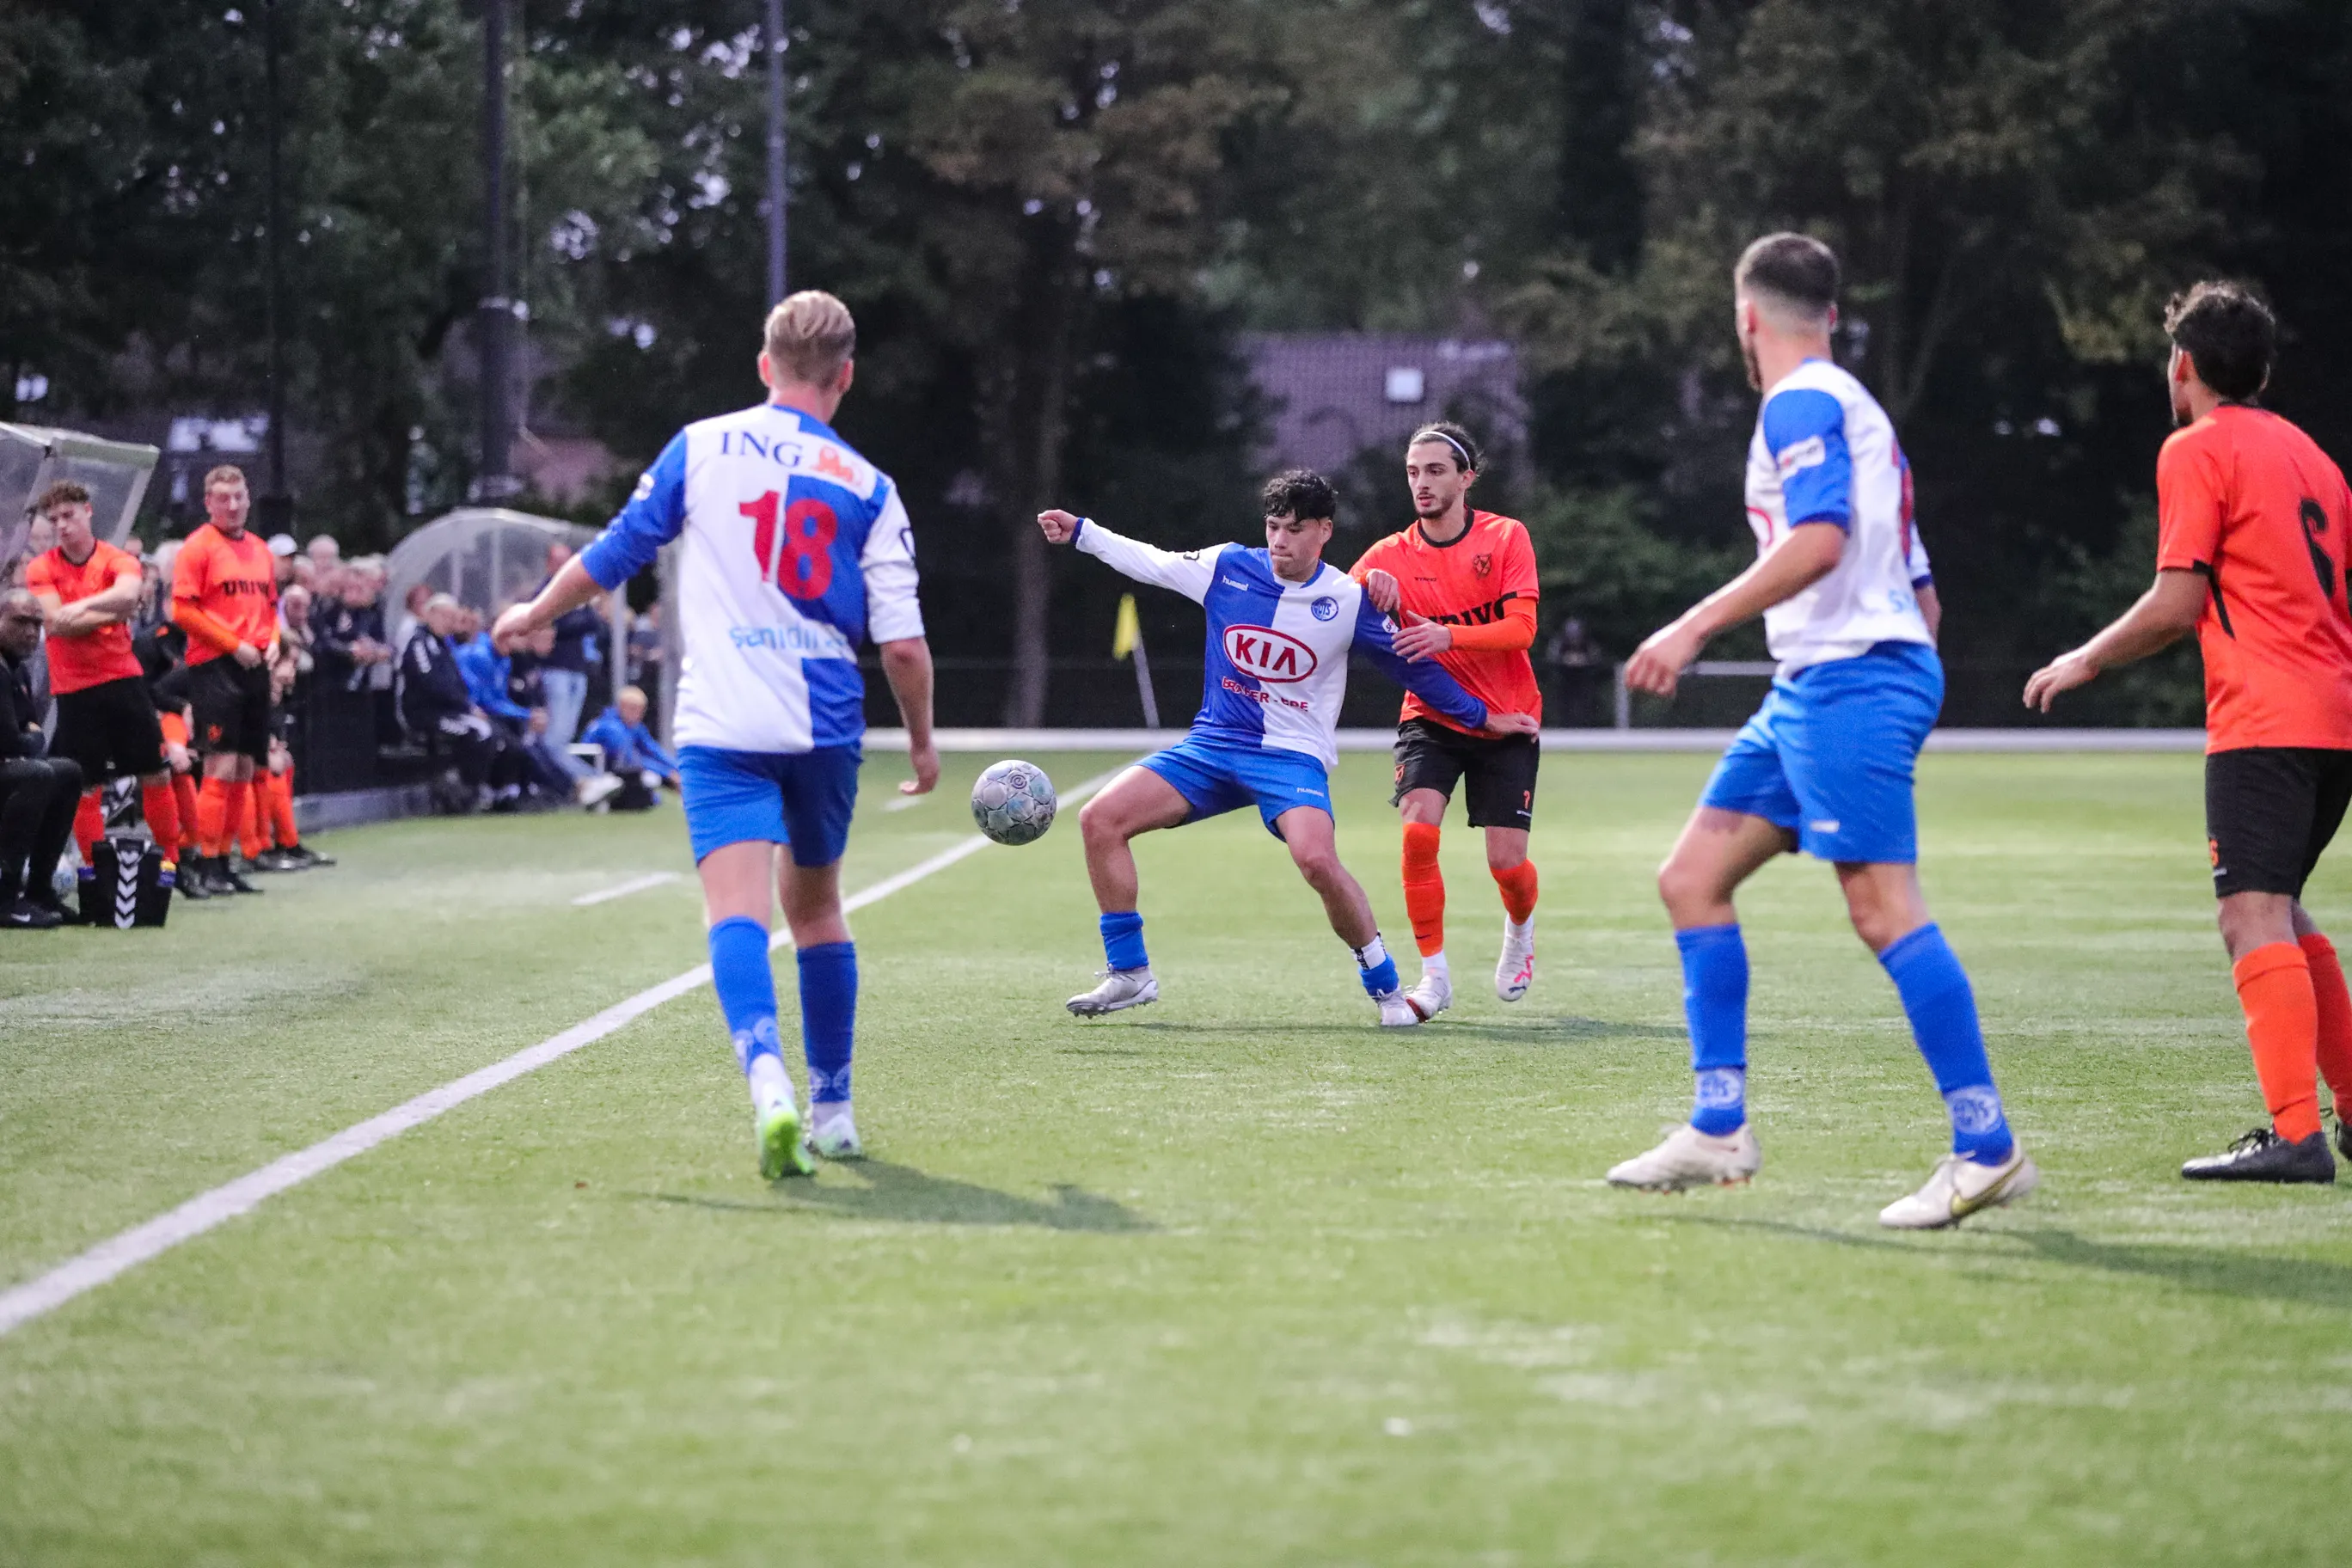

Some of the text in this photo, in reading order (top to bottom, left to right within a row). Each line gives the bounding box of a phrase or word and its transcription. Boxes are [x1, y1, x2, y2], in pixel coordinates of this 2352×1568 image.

[720, 431, 803, 469] ING
[738, 489, 838, 600] 18
[1235, 633, 1296, 676] KIA
